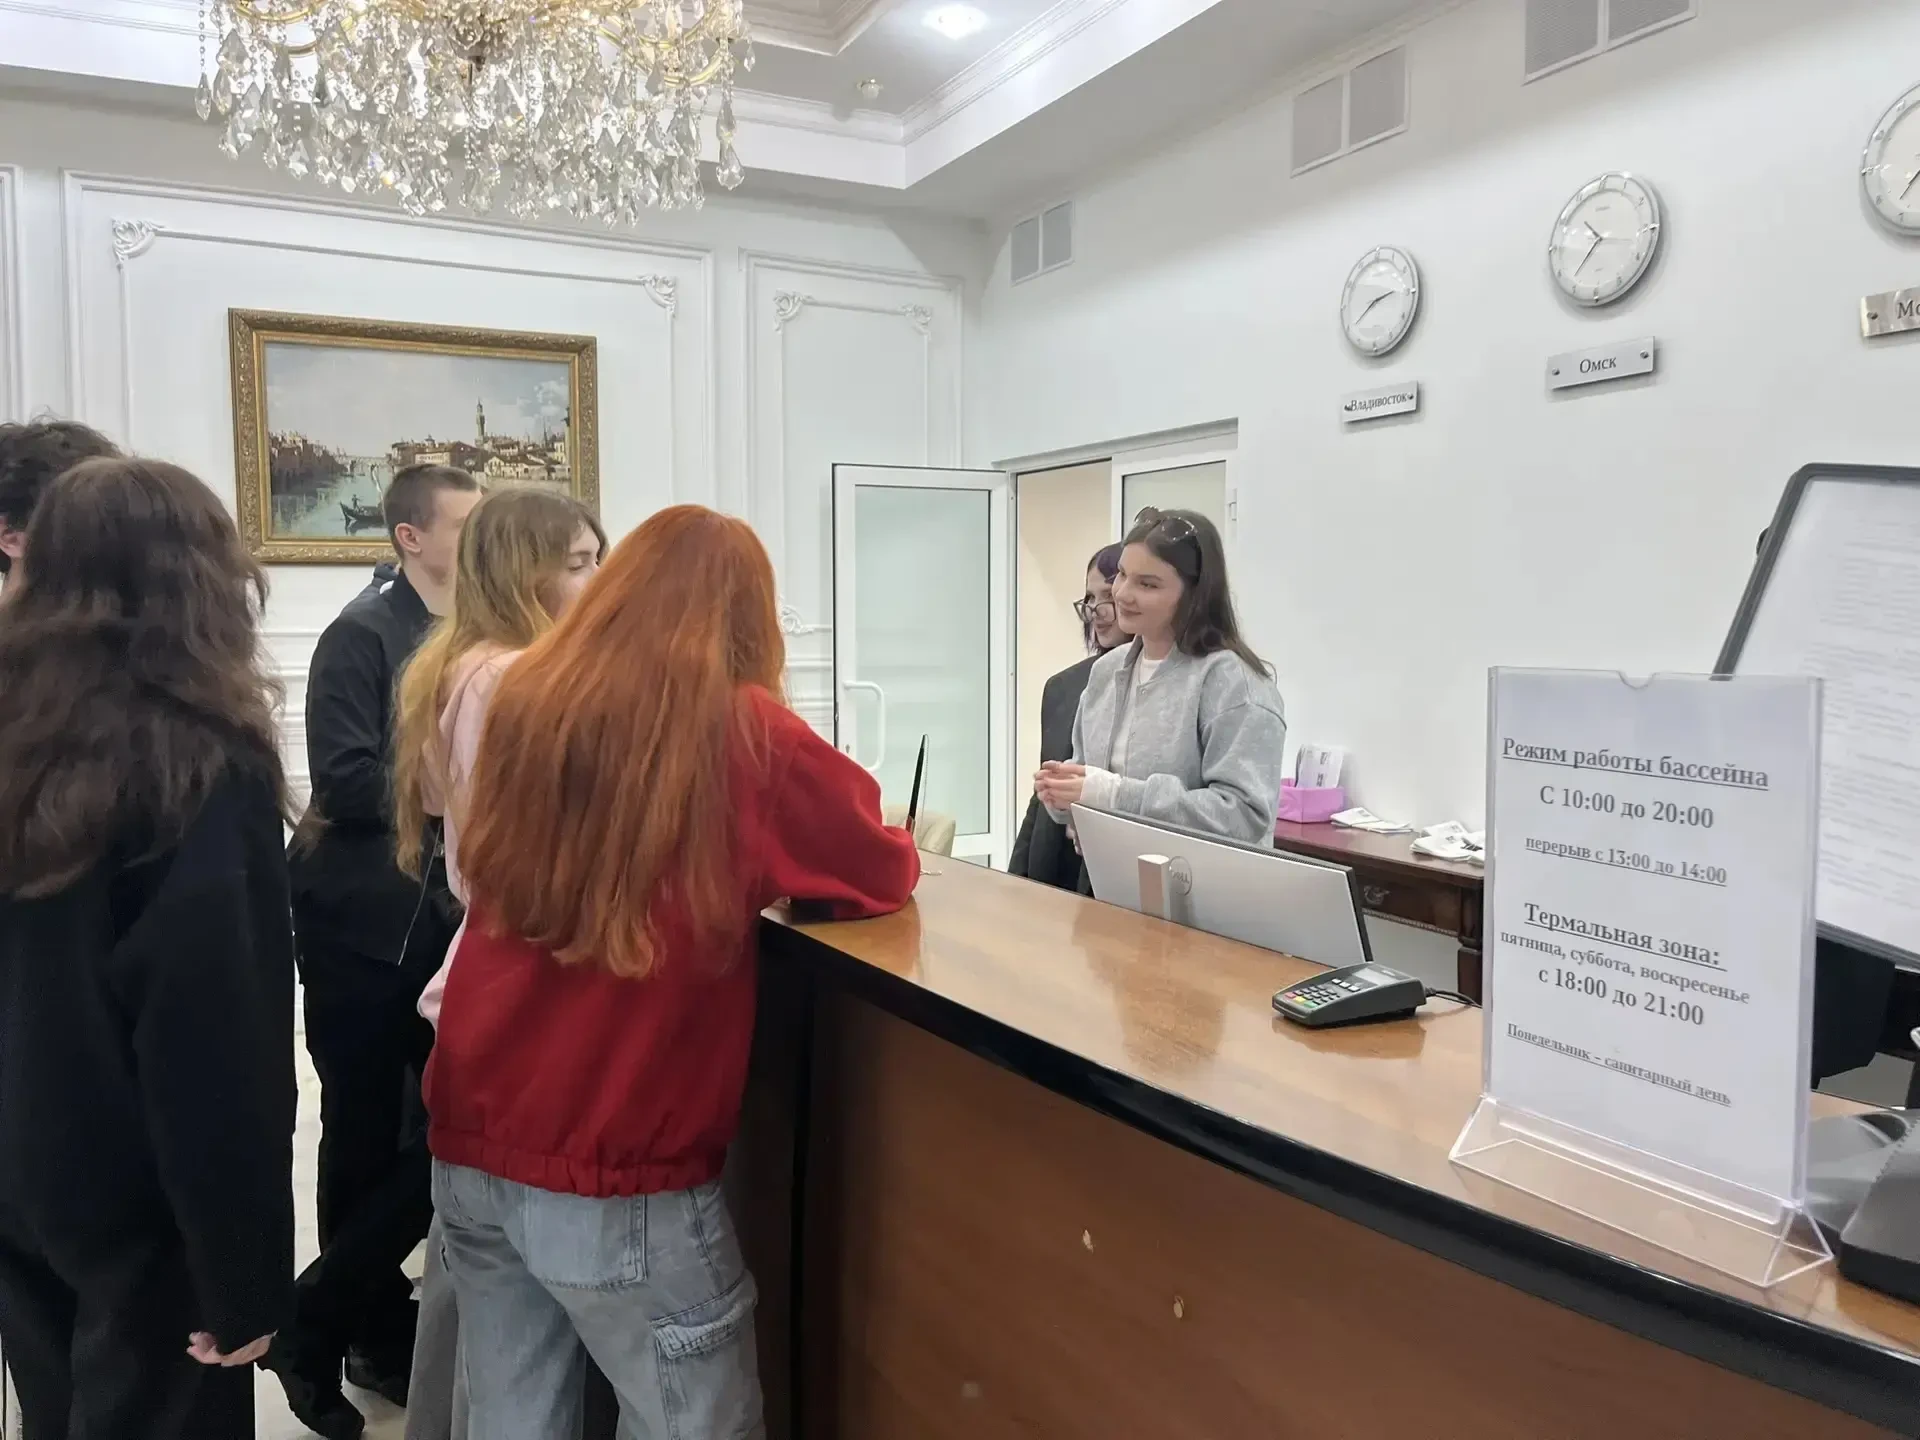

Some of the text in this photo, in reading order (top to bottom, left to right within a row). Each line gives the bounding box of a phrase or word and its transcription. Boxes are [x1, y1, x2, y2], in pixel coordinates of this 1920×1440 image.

[1580, 357, 1617, 374] Омск
[1350, 393, 1408, 412] Владивосток
[1503, 737, 1769, 787] Режим работы бассейна
[1539, 785, 1714, 829] С 10:00 до 20:00
[1525, 836, 1727, 884] перерыв с 13:00 до 14:00
[1524, 902, 1720, 966] Термальная зона:
[1500, 931, 1750, 1004] пятница, суббота, воскресенье
[1538, 968, 1704, 1026] с 18:00 до 21:00
[1507, 1023, 1591, 1061] Понедельник
[1604, 1054, 1692, 1093] санитарный
[1695, 1085, 1732, 1105] день
